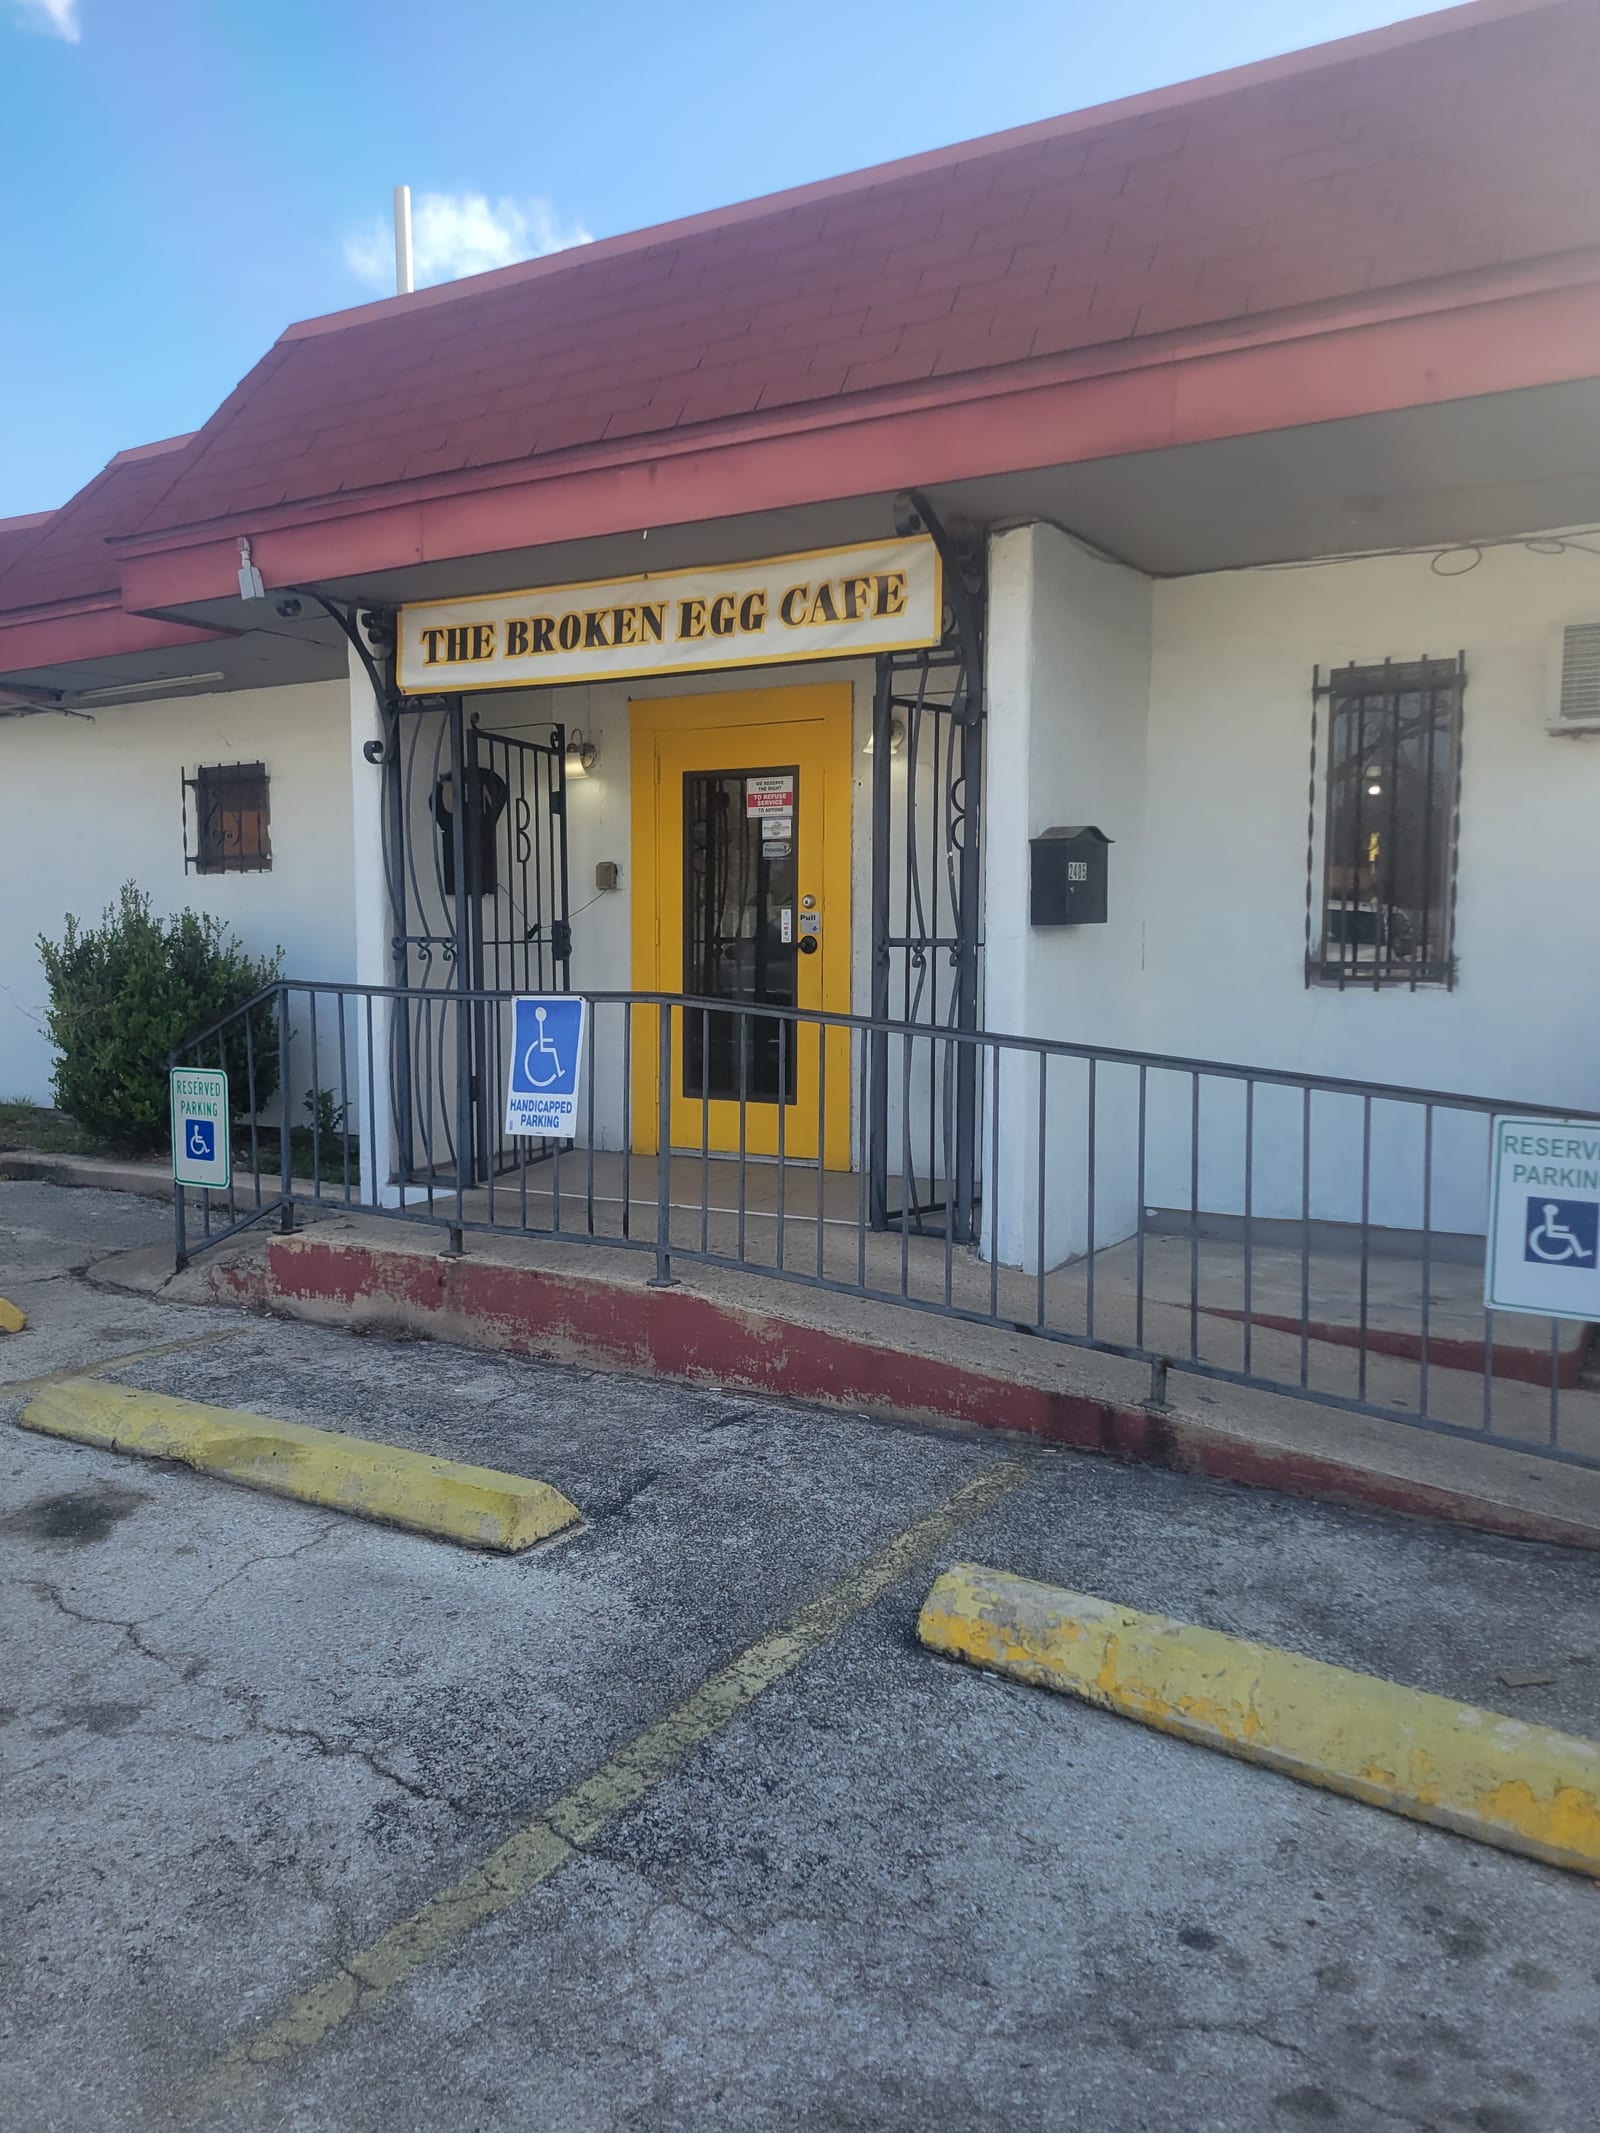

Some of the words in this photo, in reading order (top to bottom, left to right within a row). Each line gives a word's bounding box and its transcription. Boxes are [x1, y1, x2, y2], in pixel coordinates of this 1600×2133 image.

[421, 624, 495, 665] THE
[505, 603, 667, 656] BROKEN
[677, 592, 767, 640] EGG
[779, 573, 906, 627] CAFE
[176, 1080, 221, 1097] RESERVED
[180, 1100, 218, 1117] PARKING
[510, 1098, 573, 1114] HANDICAPPED
[520, 1114, 560, 1128] PARKING
[1503, 1135, 1600, 1161] RESERV
[1512, 1164, 1600, 1190] PARKIN
